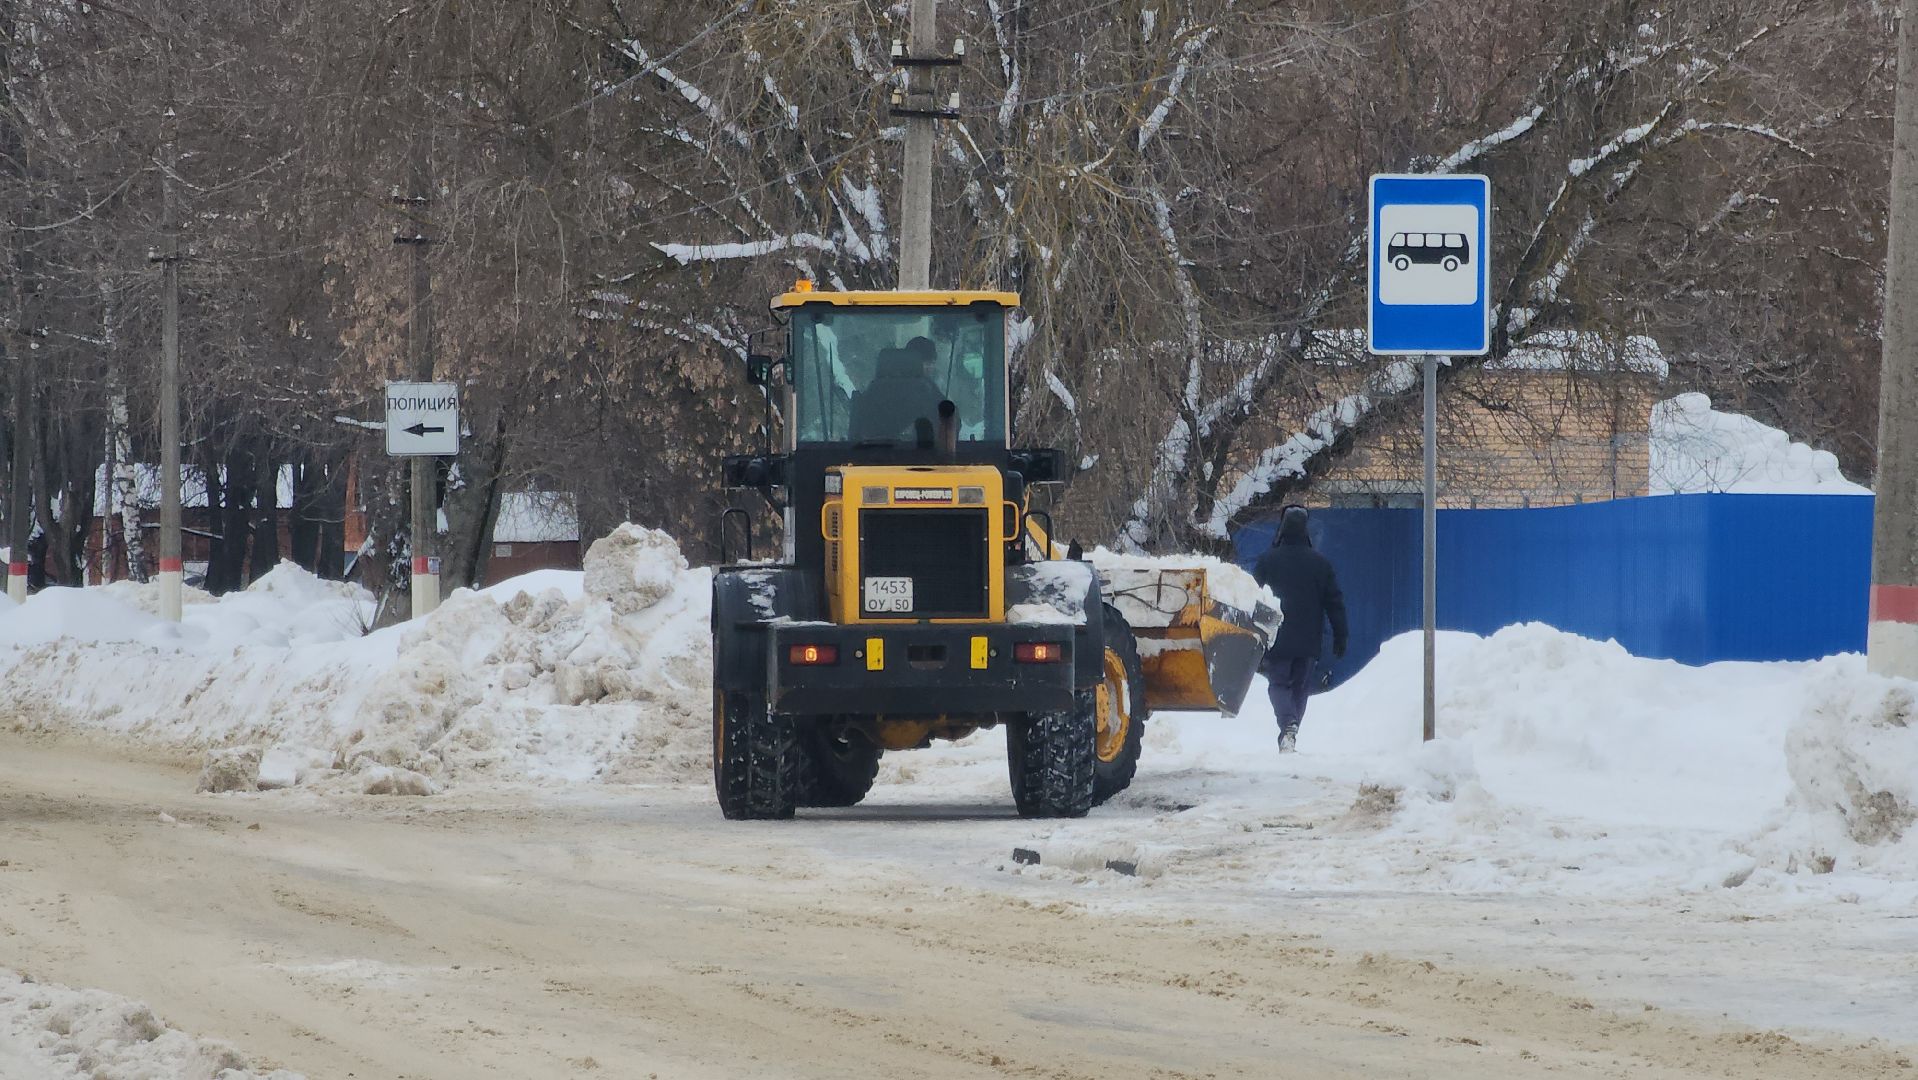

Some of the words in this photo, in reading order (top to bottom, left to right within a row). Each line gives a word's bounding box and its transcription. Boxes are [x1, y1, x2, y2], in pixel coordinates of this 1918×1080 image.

[387, 397, 456, 411] ПОЛИЦИЯ
[872, 580, 907, 594] 1453
[868, 599, 886, 610] ОУ
[895, 599, 909, 610] 50
